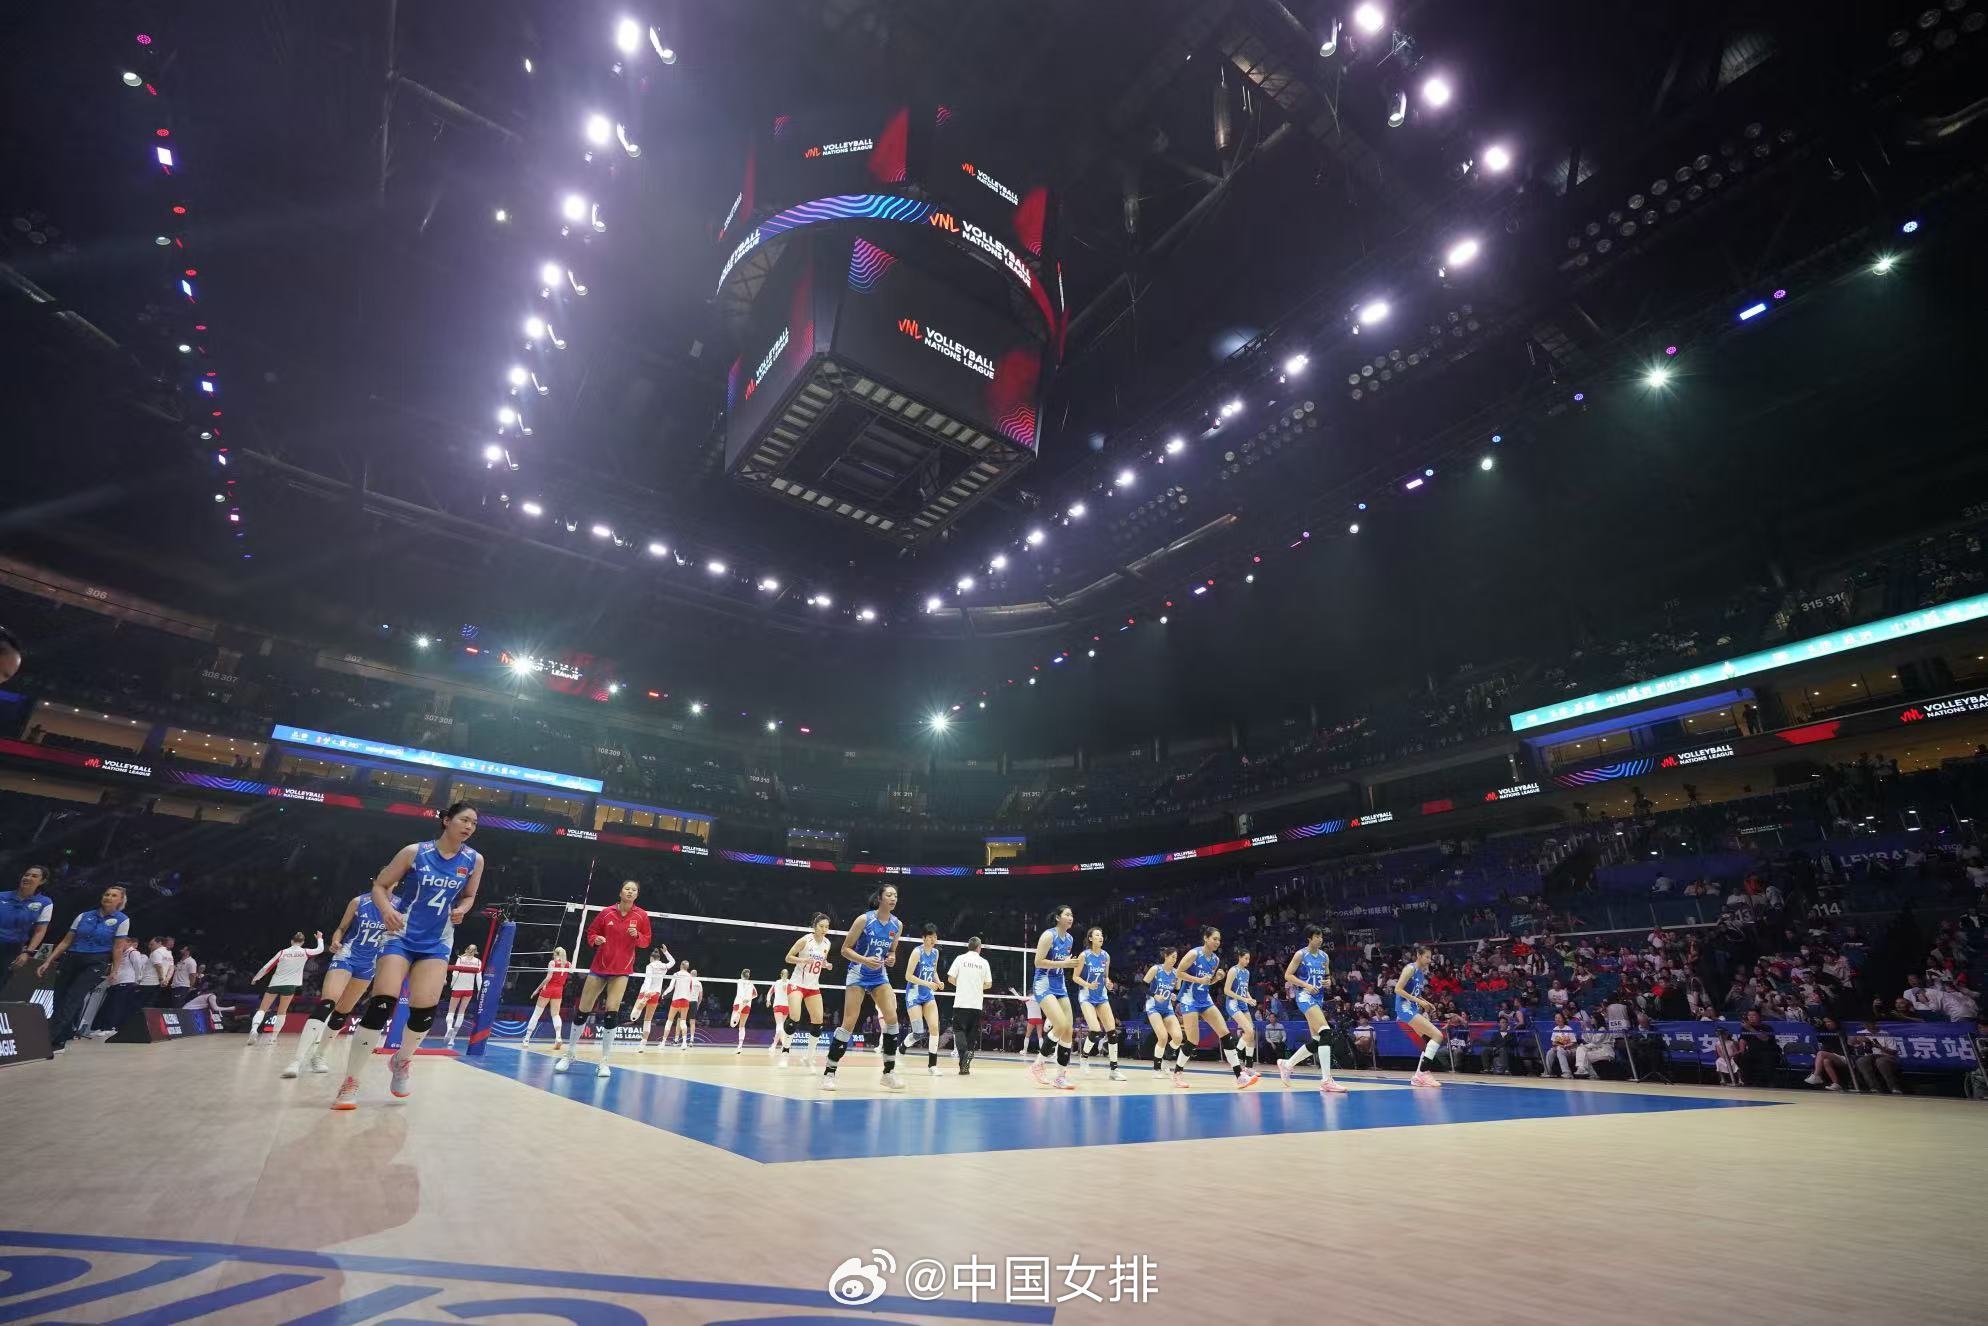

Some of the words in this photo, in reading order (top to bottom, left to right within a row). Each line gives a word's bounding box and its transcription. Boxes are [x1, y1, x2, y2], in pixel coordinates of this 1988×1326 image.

[805, 146, 822, 159] VNL
[822, 148, 849, 157] NATIONS
[850, 145, 873, 155] LEAGUE
[823, 139, 873, 153] VOLLEYBALL
[961, 163, 977, 177] VNL
[976, 177, 999, 193] NATIONS
[1000, 190, 1019, 208] LEAGUE
[977, 170, 1019, 204] VOLLEYBALL
[930, 213, 961, 233] VNL
[963, 221, 1031, 279] VOLLEYBALL
[963, 231, 1004, 260] NATIONS
[1005, 258, 1032, 288] LEAGUE
[898, 318, 923, 340] VNL
[926, 326, 995, 372] VOLLEYBALL
[924, 337, 962, 362] NATIONS
[963, 357, 995, 380] LEAGUE
[87, 587, 108, 599] 306
[1801, 598, 1823, 612] 315
[1924, 693, 1988, 711] VOLLEYBA
[1900, 708, 1925, 722] VNL
[1926, 706, 1967, 718] NATIONS
[1678, 744, 1733, 761] VOLLEYBALL
[1679, 755, 1708, 766] NATIONS
[1709, 751, 1734, 761] LEAGUE
[102, 764, 128, 774] NATIONS
[128, 769, 152, 778] LEAGUE
[104, 759, 152, 774] VOLLEYBALL
[285, 787, 326, 800] VOLLEYBALL
[1498, 782, 1540, 796] VOLLEYBALL
[1499, 790, 1521, 800] NATIONS
[1521, 787, 1541, 797] LEAGUE
[1360, 811, 1393, 823] VOLLEYBALL
[567, 828, 598, 838] VOLLEYBALL
[422, 875, 462, 890] Haier
[427, 889, 447, 916] 4
[1813, 902, 1841, 918] 114
[360, 919, 386, 930] Haie
[360, 928, 383, 949] 14
[808, 961, 821, 975] 18
[922, 971, 933, 982] 16
[1094, 973, 1102, 983] 7
